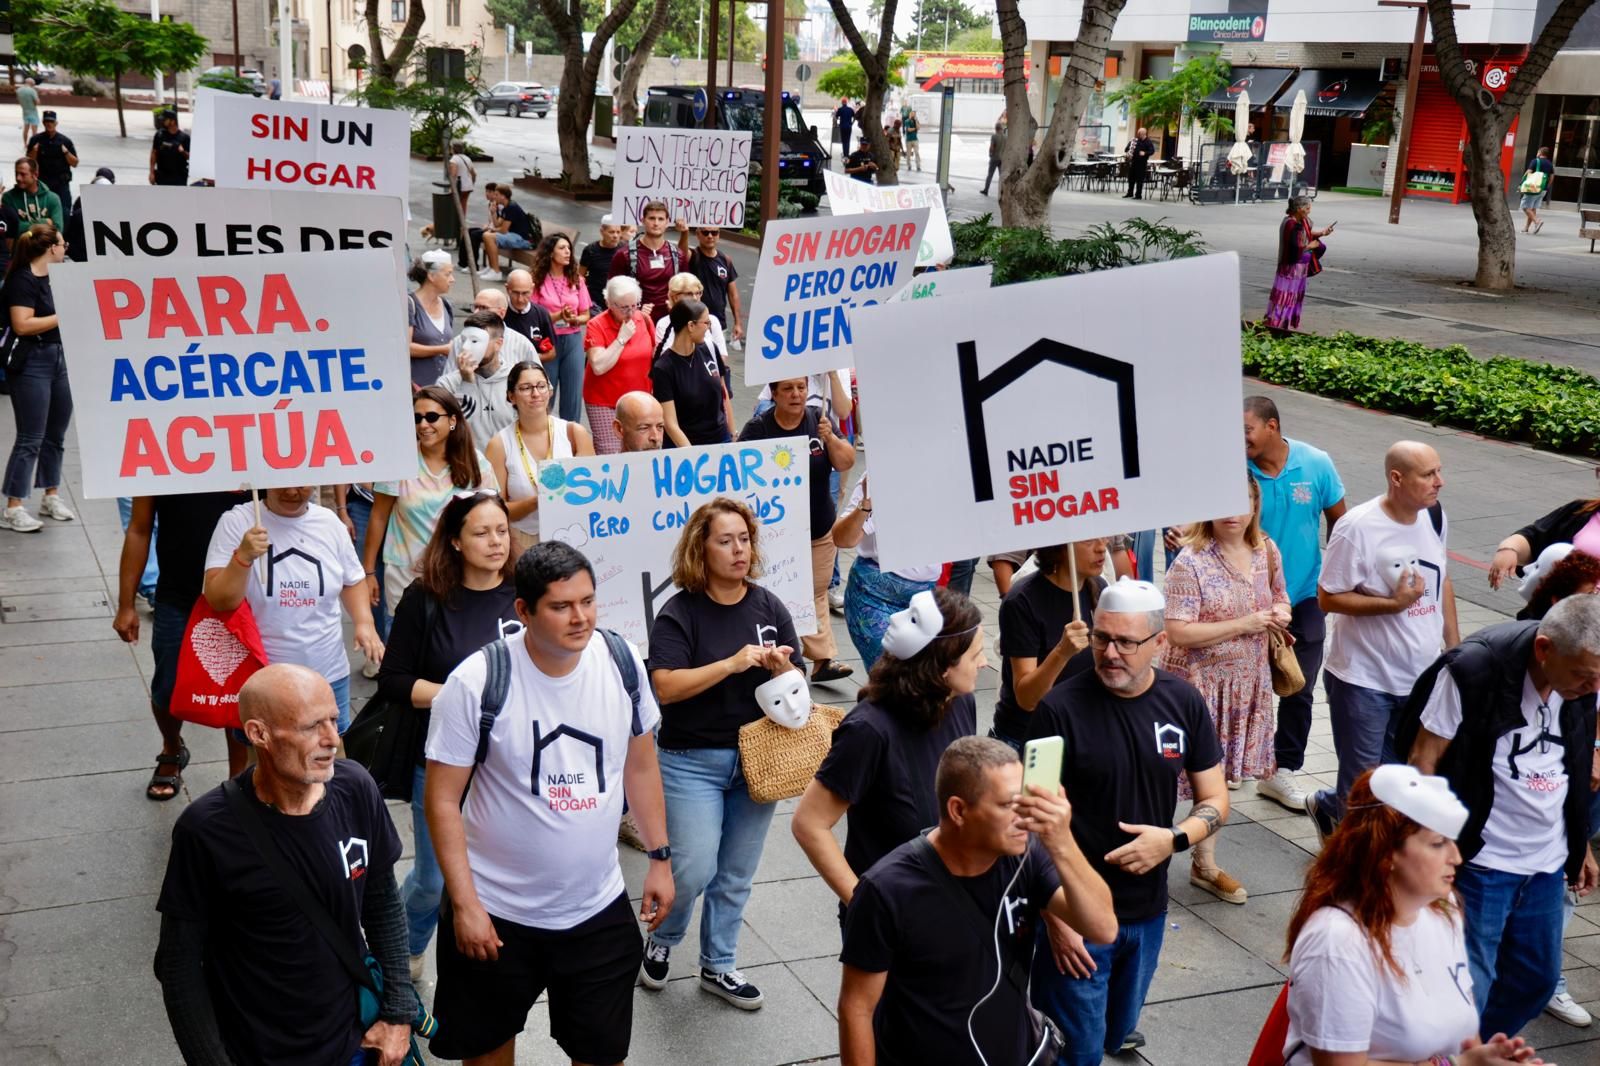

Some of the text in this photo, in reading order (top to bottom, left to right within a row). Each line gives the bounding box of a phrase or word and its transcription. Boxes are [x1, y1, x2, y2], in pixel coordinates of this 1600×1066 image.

[1190, 16, 1251, 31] Blancodent
[251, 113, 373, 147] SIN UN
[670, 134, 723, 167] TECHO
[728, 138, 751, 169] ES
[247, 157, 377, 190] HOGAR
[92, 220, 179, 257] NO
[195, 222, 284, 257] LES
[772, 231, 823, 266] SIN
[824, 222, 917, 260] HOGAR
[783, 261, 898, 302] PERO CON
[93, 273, 330, 341] PARA.
[110, 342, 384, 403] ACÉRCATE.
[119, 398, 375, 478] ACTÚA.
[1006, 437, 1094, 472] NADIE
[1009, 469, 1060, 499] SIN
[588, 511, 631, 540] PERO
[652, 501, 691, 532] CON
[1012, 487, 1120, 526] HOGAR
[280, 580, 310, 589] NADIE
[280, 589, 297, 599] SIN
[279, 598, 316, 608] HOGAR
[1407, 604, 1436, 618] HOGAR
[547, 773, 586, 786] NADIE
[548, 786, 571, 799] SIN
[549, 797, 598, 811] HOGAR
